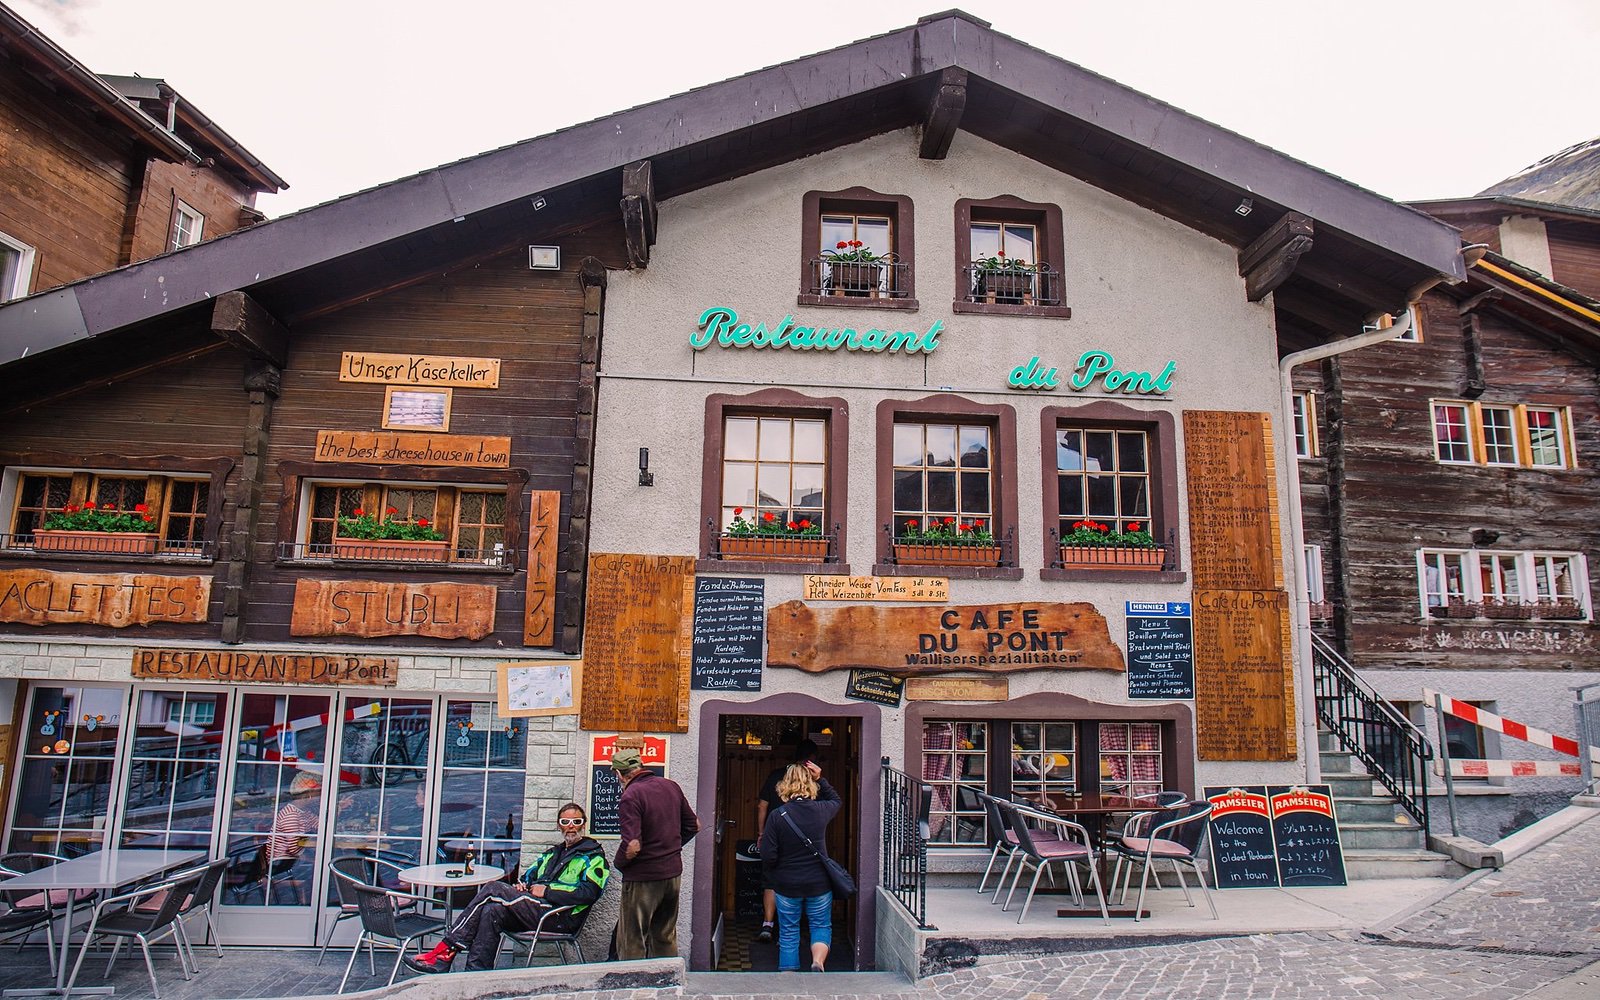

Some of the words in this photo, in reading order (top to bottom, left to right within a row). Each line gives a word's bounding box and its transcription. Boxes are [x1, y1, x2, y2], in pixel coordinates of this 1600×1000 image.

[690, 307, 943, 354] Restaurant
[350, 355, 404, 379] Unser
[407, 357, 490, 383] Käsekeller
[1007, 356, 1060, 391] du
[1069, 351, 1177, 394] Pont
[320, 435, 345, 457] the
[347, 437, 379, 459] best
[464, 449, 474, 463] in
[477, 441, 506, 464] town
[528, 495, 550, 642] レストラン
[698, 580, 729, 591] Fondue
[809, 576, 845, 588] Schneider
[848, 578, 872, 589] Weisse
[876, 582, 893, 594] Vom
[893, 582, 906, 593] Fass
[0, 580, 187, 617] ACLETTES
[832, 589, 876, 599] Weizenbier
[332, 590, 461, 624] STUBLI
[940, 609, 1040, 632] CAFE
[1141, 619, 1161, 628] Menu
[919, 633, 959, 654] DU
[987, 631, 1068, 653] PONT
[140, 651, 306, 680] RESTAURANT
[309, 656, 343, 680] Du
[344, 657, 391, 681] Pont
[905, 653, 1079, 667] Walliserspezialitäten
[1213, 798, 1265, 811] RAMSEIER
[1275, 798, 1327, 811] RAMSEIER
[1214, 822, 1264, 835] Welcome
[1220, 840, 1229, 849] to
[1234, 840, 1247, 848] the
[1221, 852, 1246, 863] oldest
[1230, 869, 1241, 881] in
[1245, 868, 1269, 881] town
